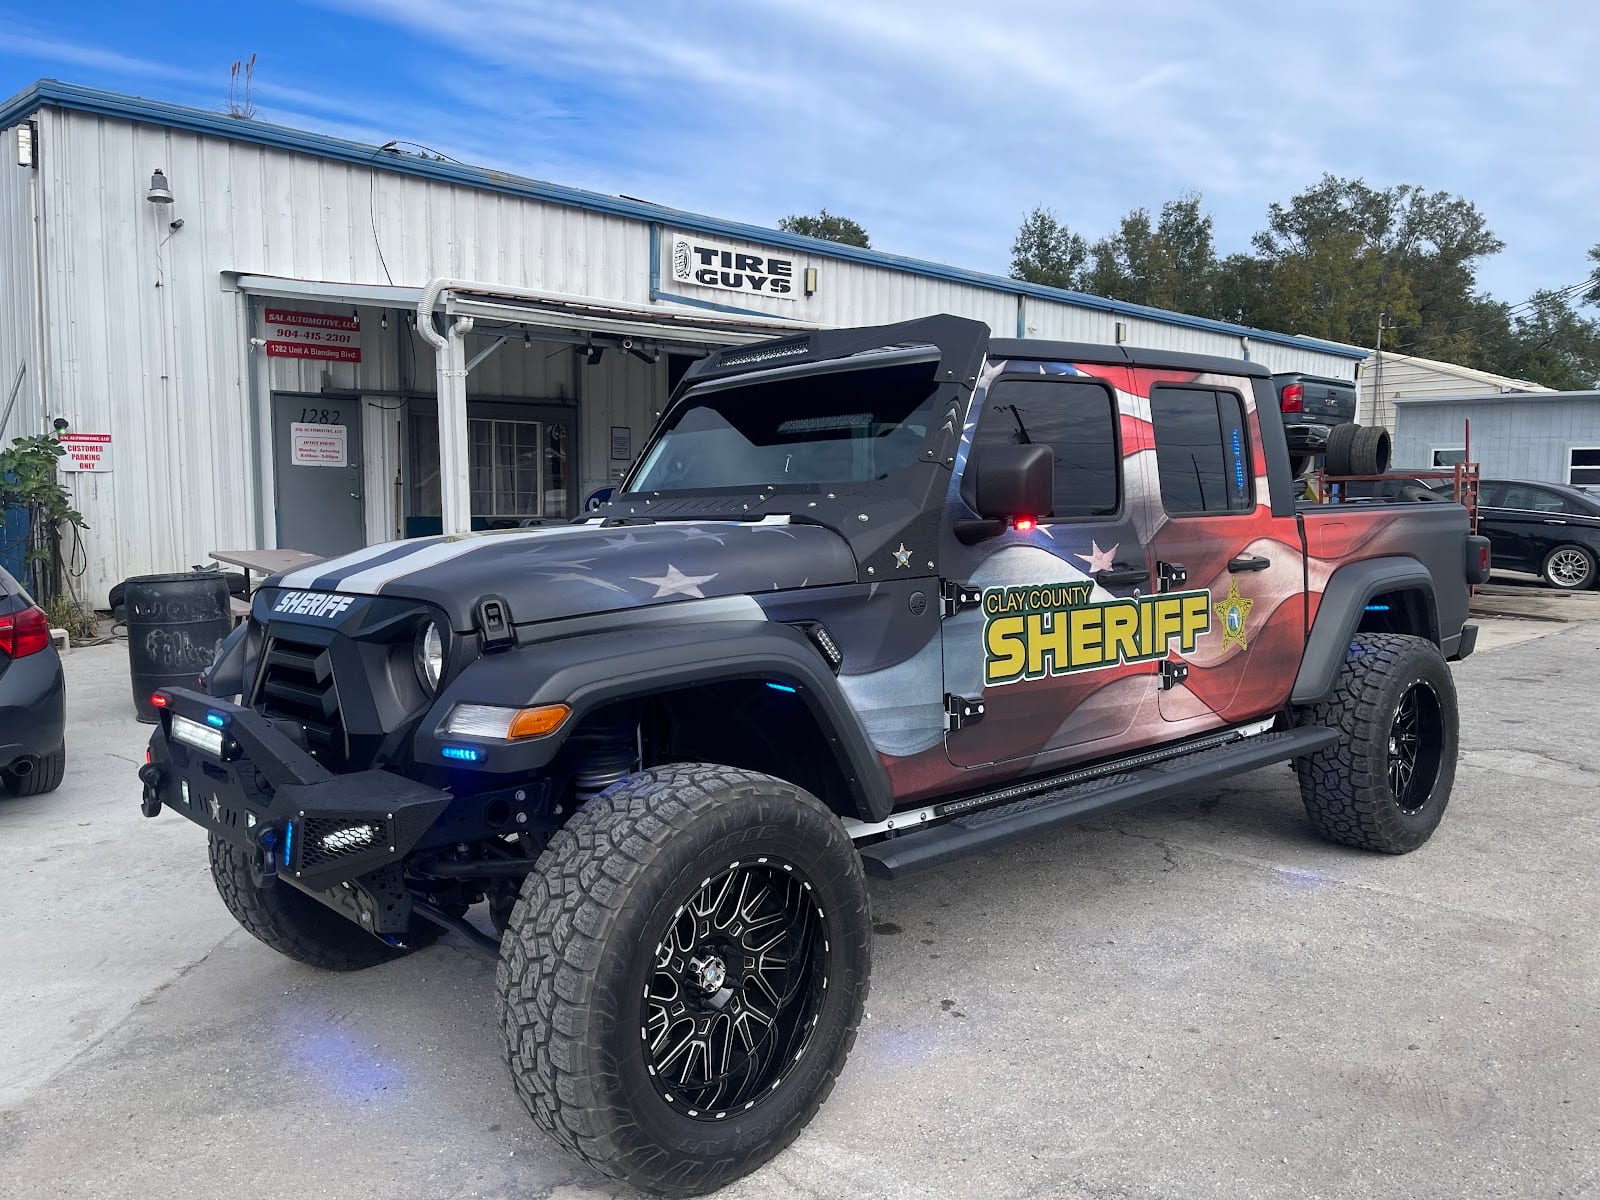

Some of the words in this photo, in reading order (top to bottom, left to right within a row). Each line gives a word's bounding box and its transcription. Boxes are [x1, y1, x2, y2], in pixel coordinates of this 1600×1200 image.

[694, 246, 792, 277] TIRE
[695, 268, 792, 294] GUYS
[286, 315, 341, 328] AUTOMOTIVE,
[276, 328, 351, 343] 904-415-2301
[271, 344, 287, 353] 1282
[288, 345, 303, 355] Unit
[303, 347, 310, 355] A
[310, 348, 340, 358] Blanding
[340, 351, 357, 359] Blvd.
[300, 408, 340, 425] 1282
[67, 445, 104, 453] CUSTOMER
[71, 453, 101, 461] PARKING
[79, 462, 96, 470] ONLY
[274, 591, 356, 619] SHERIFF
[986, 591, 1026, 613] CLAY
[1029, 586, 1093, 609] COUNTY
[988, 595, 1208, 679] SHERIFF
